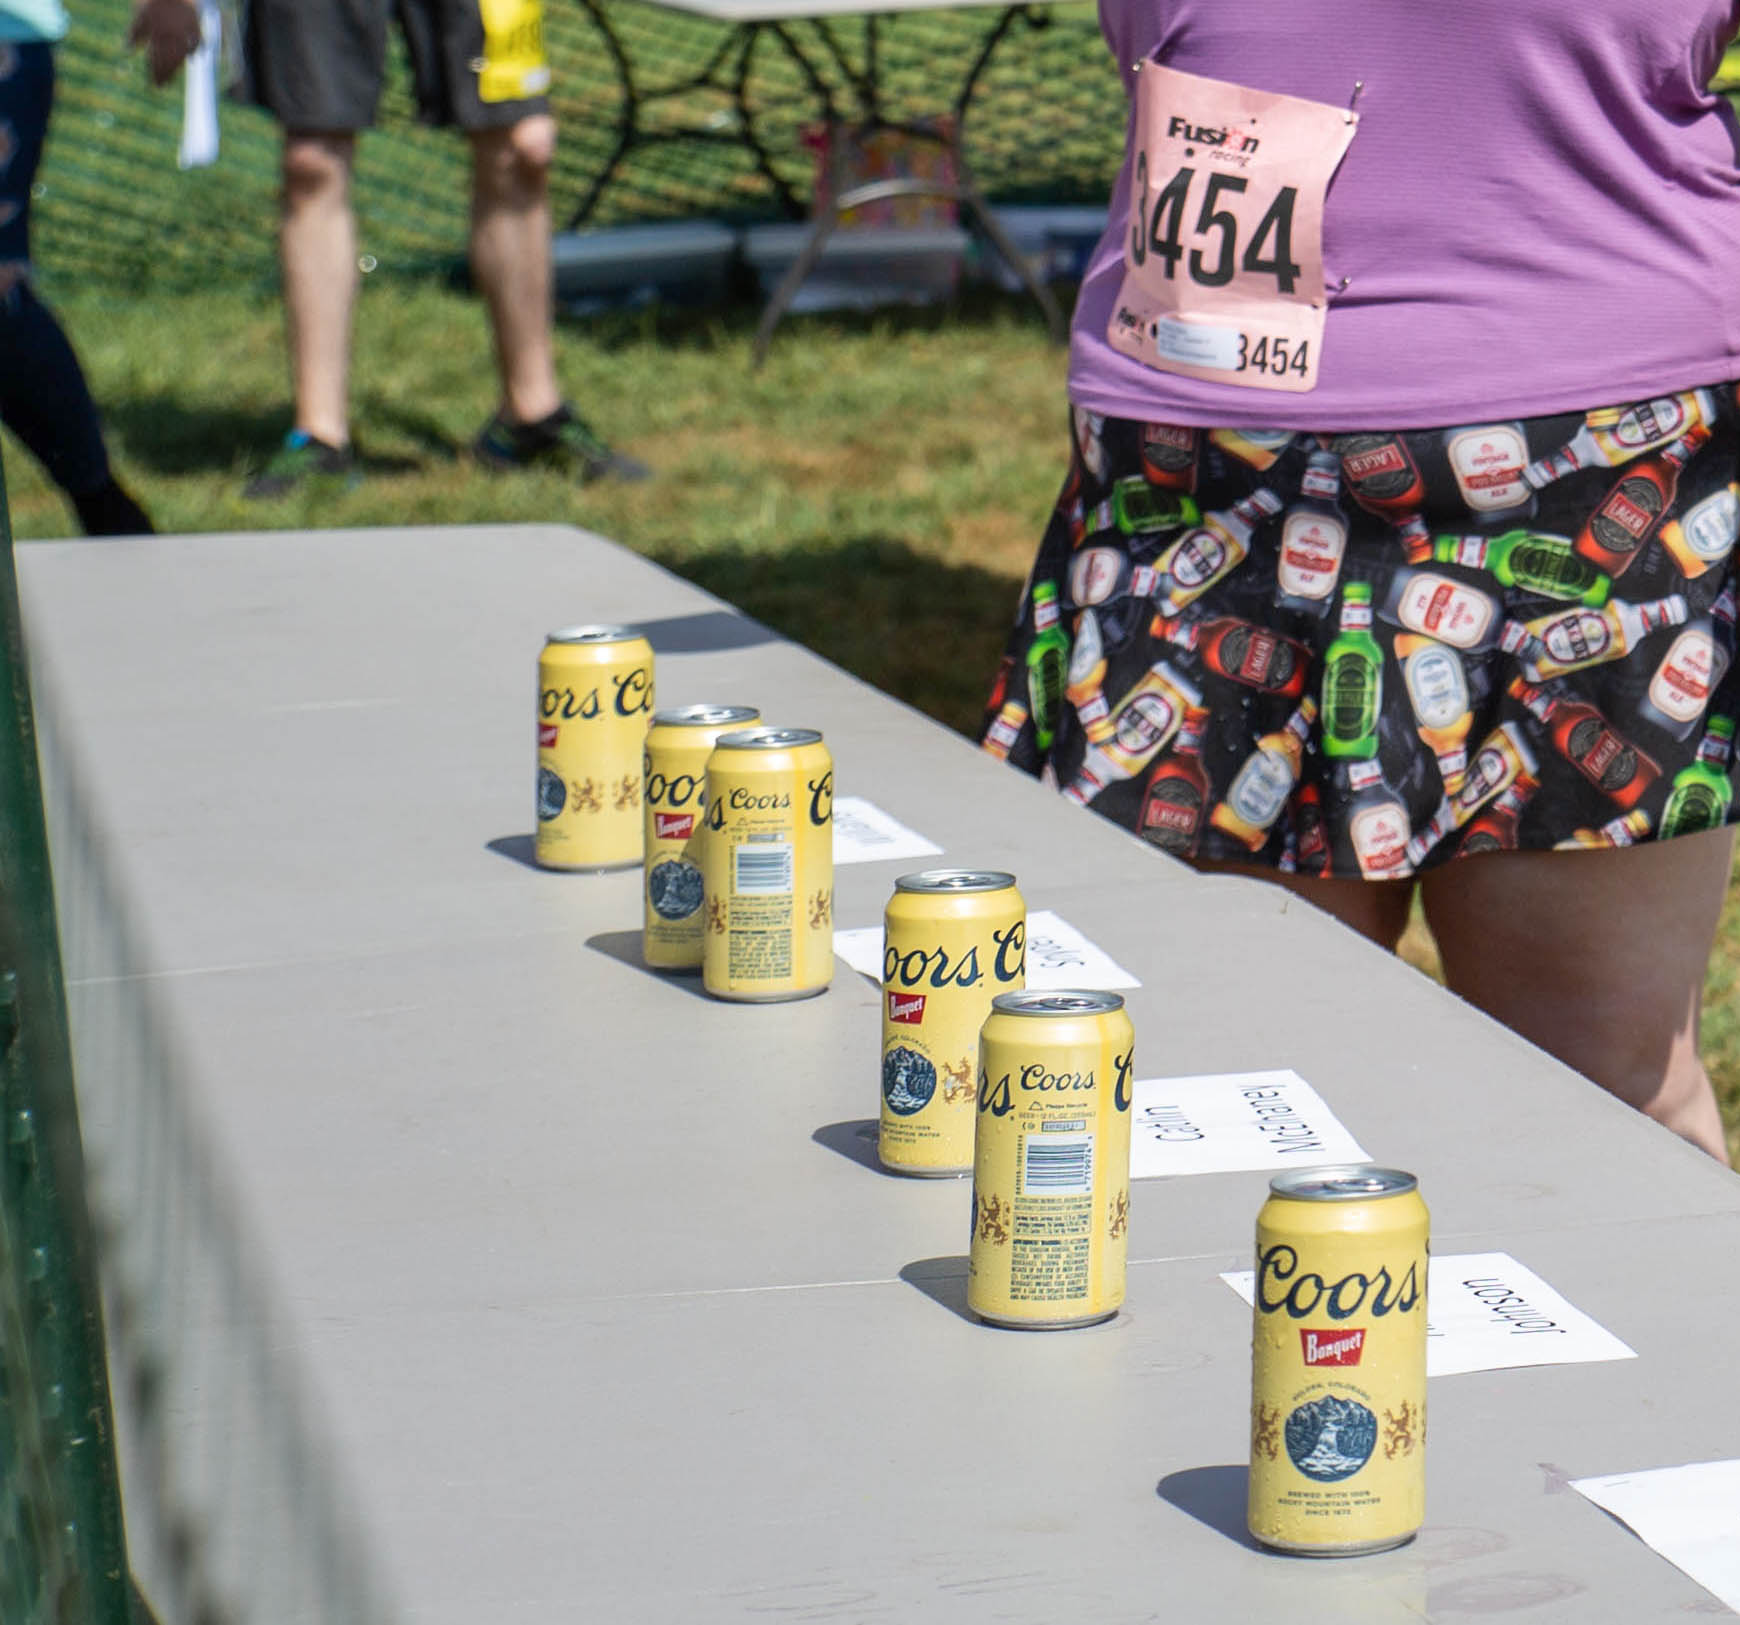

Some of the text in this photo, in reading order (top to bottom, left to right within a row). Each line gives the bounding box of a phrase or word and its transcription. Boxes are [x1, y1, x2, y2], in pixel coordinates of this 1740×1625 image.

[1167, 116, 1261, 154] Fusion
[1208, 149, 1252, 168] racing
[1609, 502, 1645, 532] LAGER
[730, 787, 791, 811] Coors
[889, 994, 925, 1021] Banquet
[1020, 1063, 1096, 1091] Coors
[1256, 1244, 1421, 1320] Coors
[1462, 1276, 1567, 1335] Johnson
[1306, 1331, 1363, 1366] Banquet
